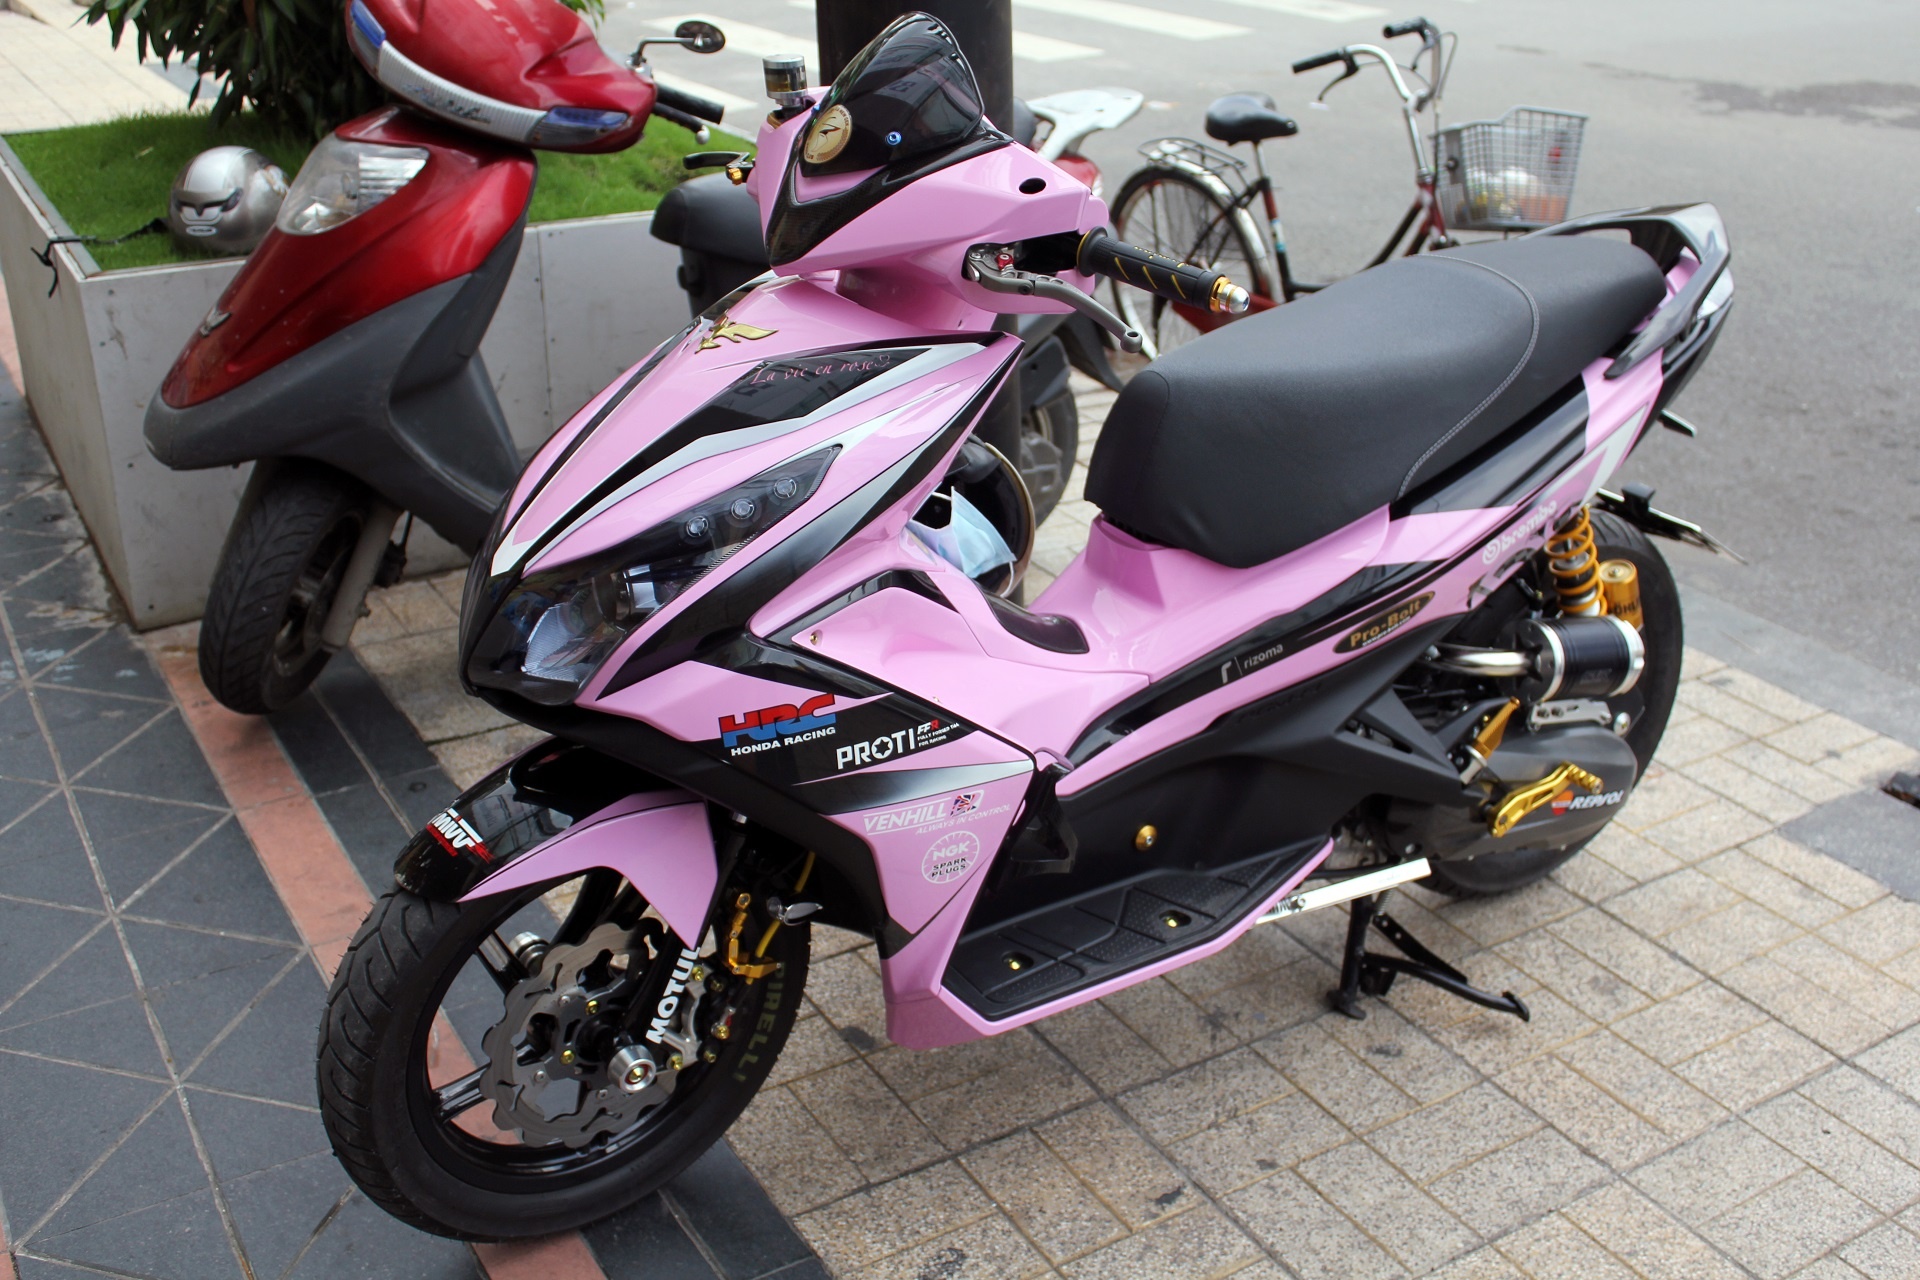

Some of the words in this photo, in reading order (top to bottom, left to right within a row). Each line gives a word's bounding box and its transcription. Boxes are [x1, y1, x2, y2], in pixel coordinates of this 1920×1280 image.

[750, 367, 776, 385] La
[784, 364, 809, 380] vie
[815, 363, 832, 375] en
[840, 359, 874, 374] rose
[1500, 500, 1557, 552] brembo
[1350, 600, 1421, 648] Pro-Bolt
[1244, 643, 1284, 669] rizoma
[718, 692, 837, 748] HRC
[730, 740, 782, 756] HONDA
[784, 726, 836, 746] RACING
[836, 728, 916, 770] PROTI
[917, 719, 939, 735] FFR
[864, 802, 947, 833] VENHILL
[915, 817, 954, 836] ALWAYS
[956, 815, 969, 826] IN
[968, 804, 1011, 822] CONTROL
[932, 840, 971, 861] NGK
[933, 857, 967, 871] SPARK
[931, 863, 966, 878] PLUGS
[645, 946, 702, 1044] MOTUL
[731, 961, 787, 1083] PIRELLI
